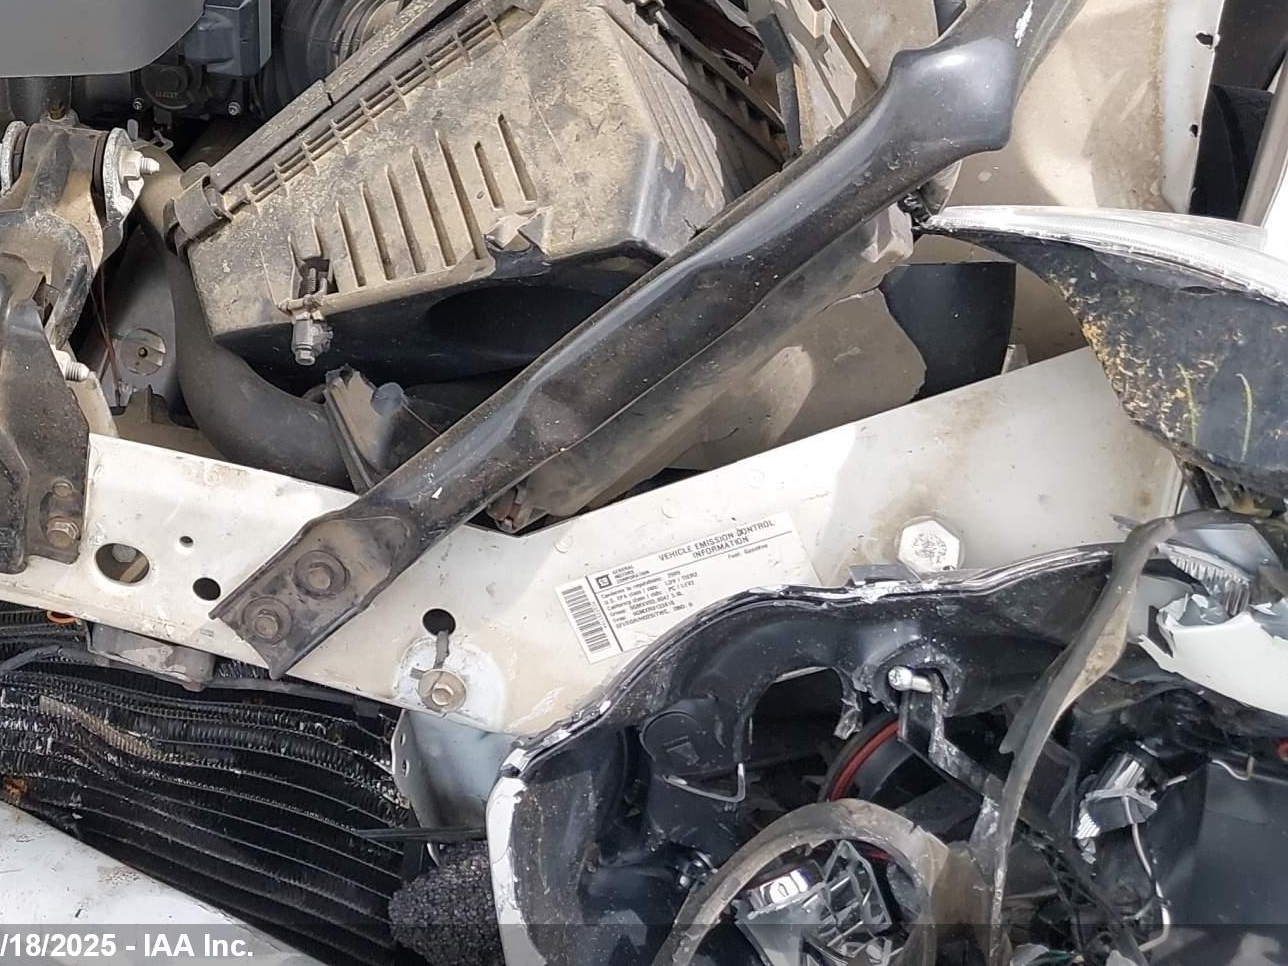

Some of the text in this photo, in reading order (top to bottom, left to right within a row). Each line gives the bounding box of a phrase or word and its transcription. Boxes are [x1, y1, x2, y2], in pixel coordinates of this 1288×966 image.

[658, 518, 775, 561] VEHICLE EMISSION CONTROL
[691, 535, 749, 559] INFORMATION
